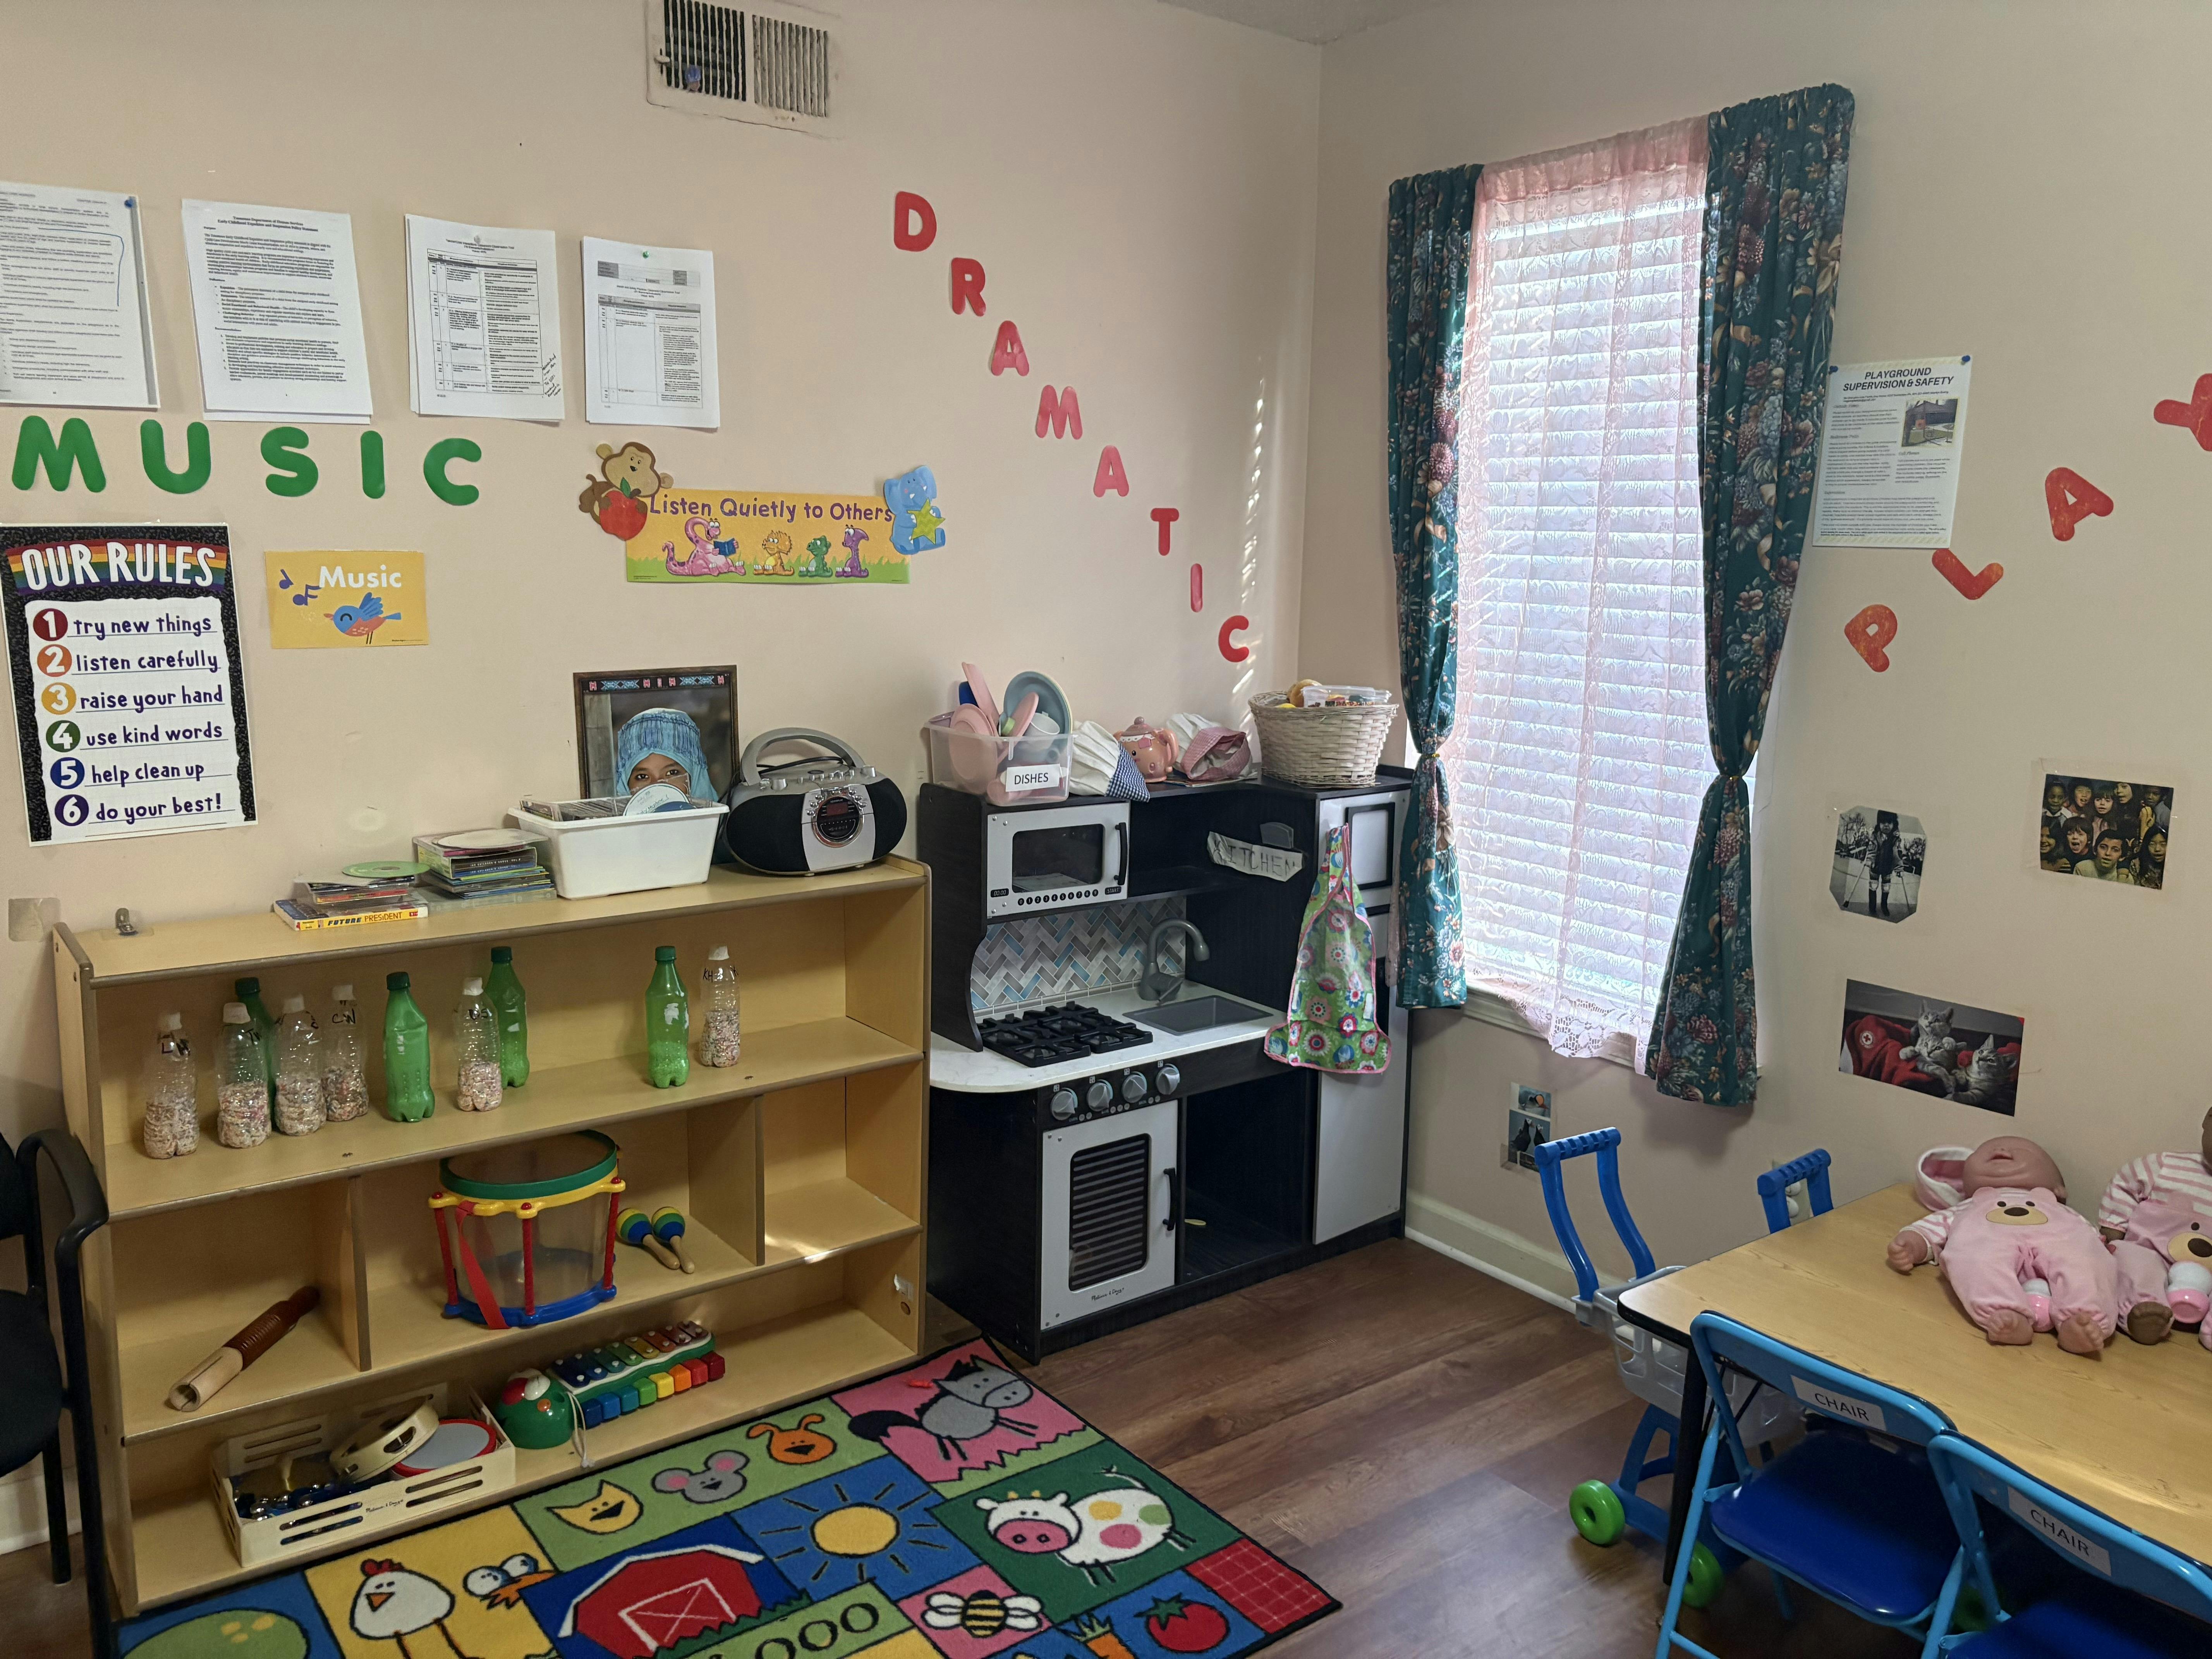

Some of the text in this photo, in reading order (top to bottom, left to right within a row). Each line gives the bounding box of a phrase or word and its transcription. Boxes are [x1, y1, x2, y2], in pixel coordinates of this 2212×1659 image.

[1843, 376, 1954, 391] SUPERVISION & SAFETY
[1865, 368, 1931, 380] PLAYGROUND
[12, 415, 482, 506] MUSIC
[650, 493, 893, 523] Listen Quietly to Others
[21, 541, 216, 590] OUR RULES
[319, 564, 402, 588] Music
[42, 611, 212, 641] 1 try new things
[45, 646, 218, 673] 2 listen carefully
[48, 684, 223, 713] 3 raise your hand
[52, 721, 223, 749] 4 use kind words
[59, 760, 204, 787] 5 help clean up
[1014, 772, 1049, 785] DISHES
[63, 793, 222, 824] 6 do your best!
[1212, 838, 1295, 877] KITCHEN
[328, 917, 362, 926] FUTURE
[1815, 1393, 1870, 1422] CHAIR
[2030, 1509, 2089, 1557] CHAIR
